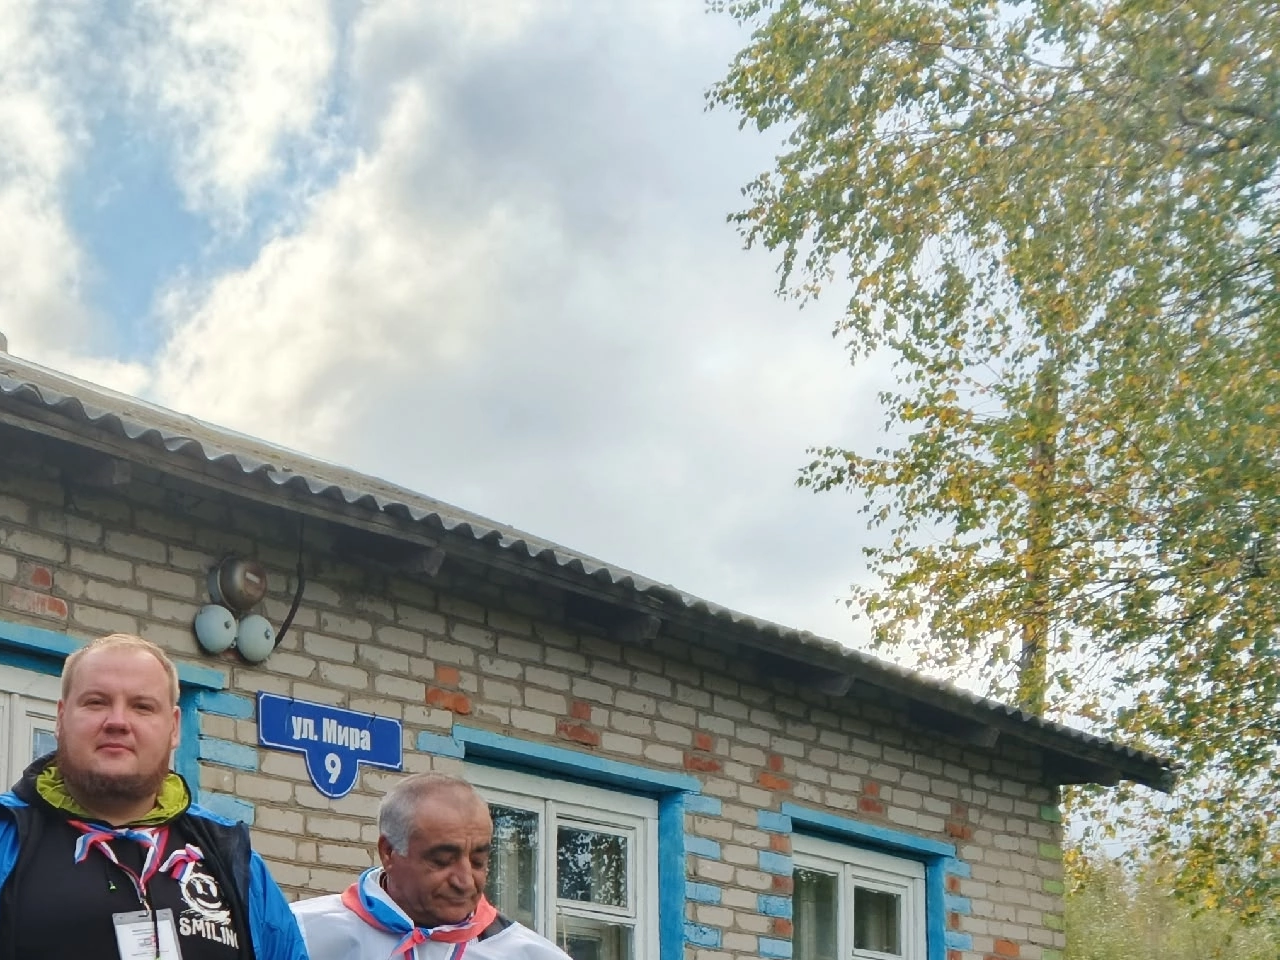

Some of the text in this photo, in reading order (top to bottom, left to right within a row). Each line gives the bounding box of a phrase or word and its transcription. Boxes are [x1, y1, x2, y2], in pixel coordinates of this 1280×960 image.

[291, 715, 371, 751] ул. Мира
[324, 752, 342, 784] 9
